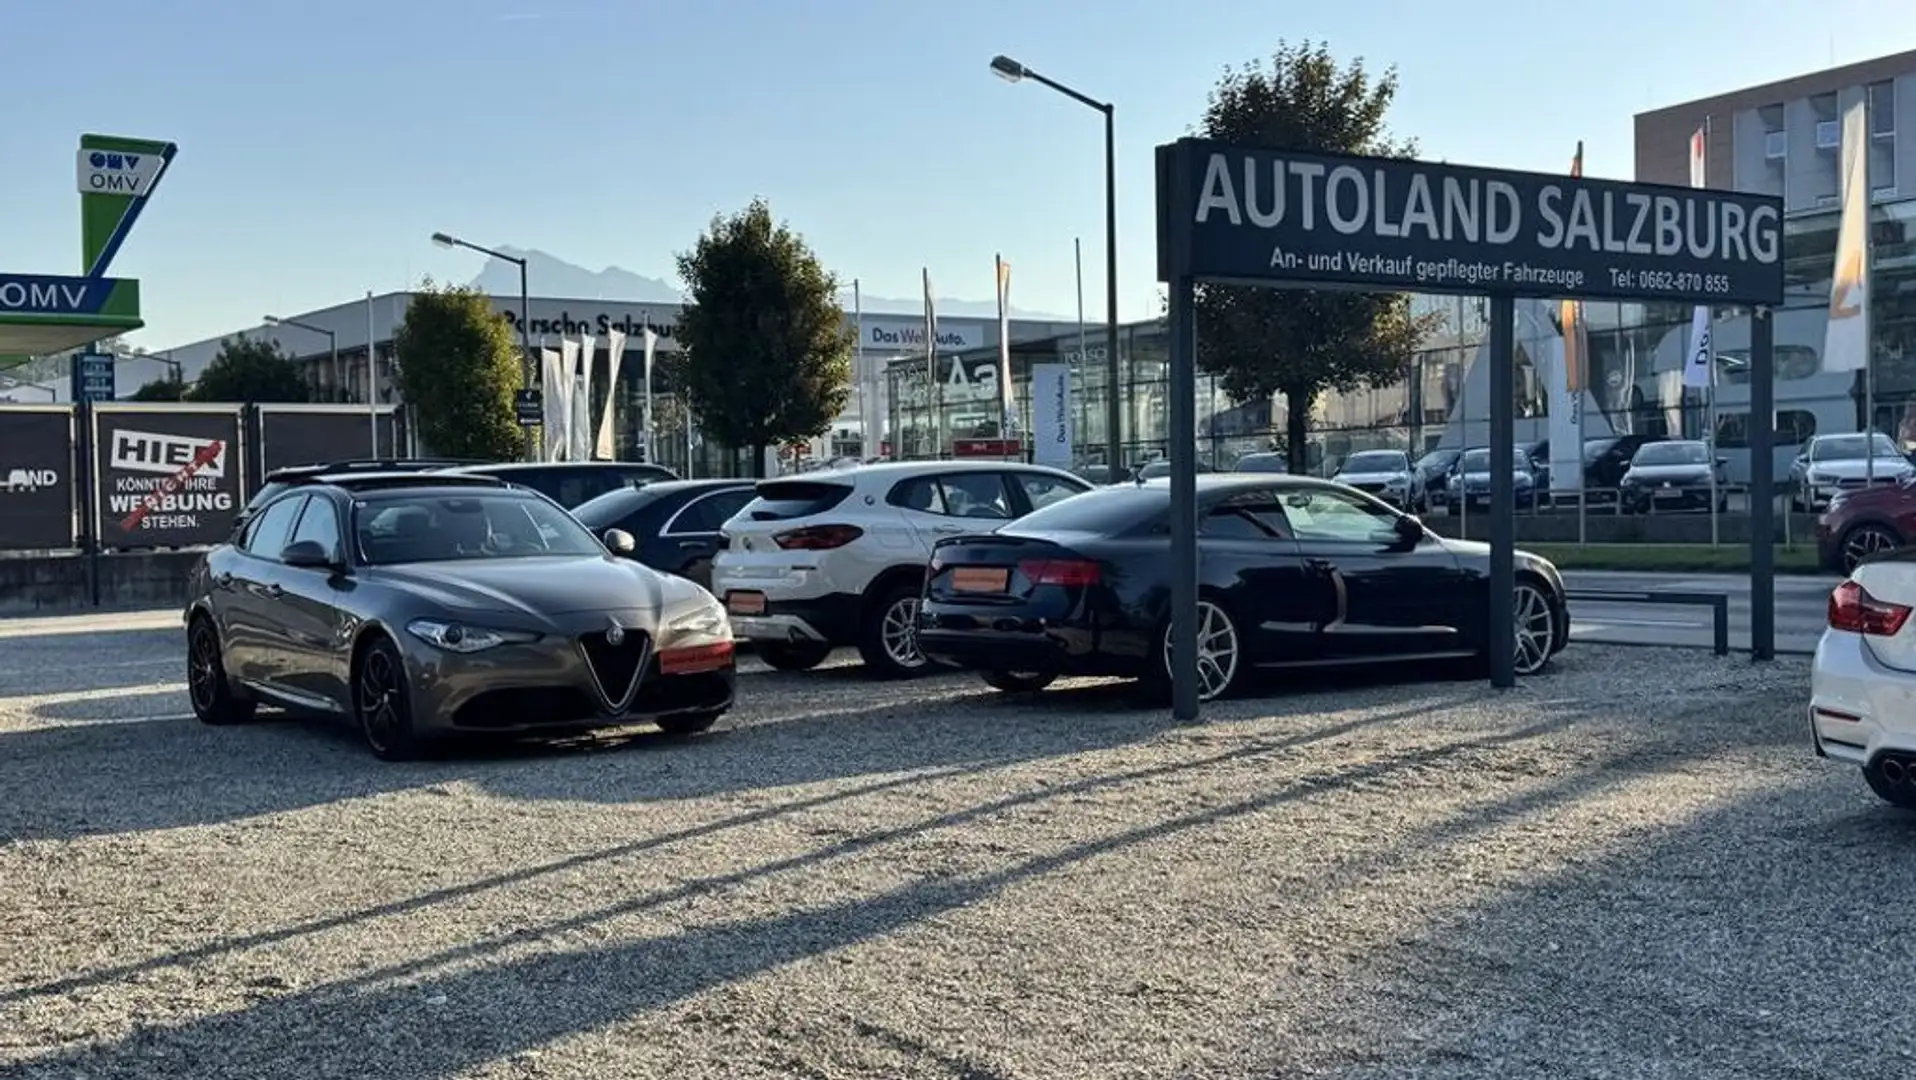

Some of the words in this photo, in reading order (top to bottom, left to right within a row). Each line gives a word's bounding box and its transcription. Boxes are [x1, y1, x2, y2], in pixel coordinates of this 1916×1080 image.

[90, 174, 139, 191] OMV
[1195, 153, 1521, 244] AUTOLAND
[1537, 185, 1779, 263] SALZBURG
[1270, 247, 1303, 268] An-
[1308, 252, 1341, 271] und
[1347, 252, 1412, 275] Verkauf
[1416, 256, 1499, 284] gepflegter
[1503, 262, 1584, 288] Fahrzeuge
[1609, 268, 1636, 287] Tel:
[1639, 271, 1701, 291] 0662-870
[1705, 274, 1729, 293] 855
[2, 283, 87, 308] OMV
[872, 327, 898, 343] Das
[184, 478, 217, 491] IHRE
[110, 493, 232, 513] WERBUNG
[142, 515, 200, 529] STEHEN.
